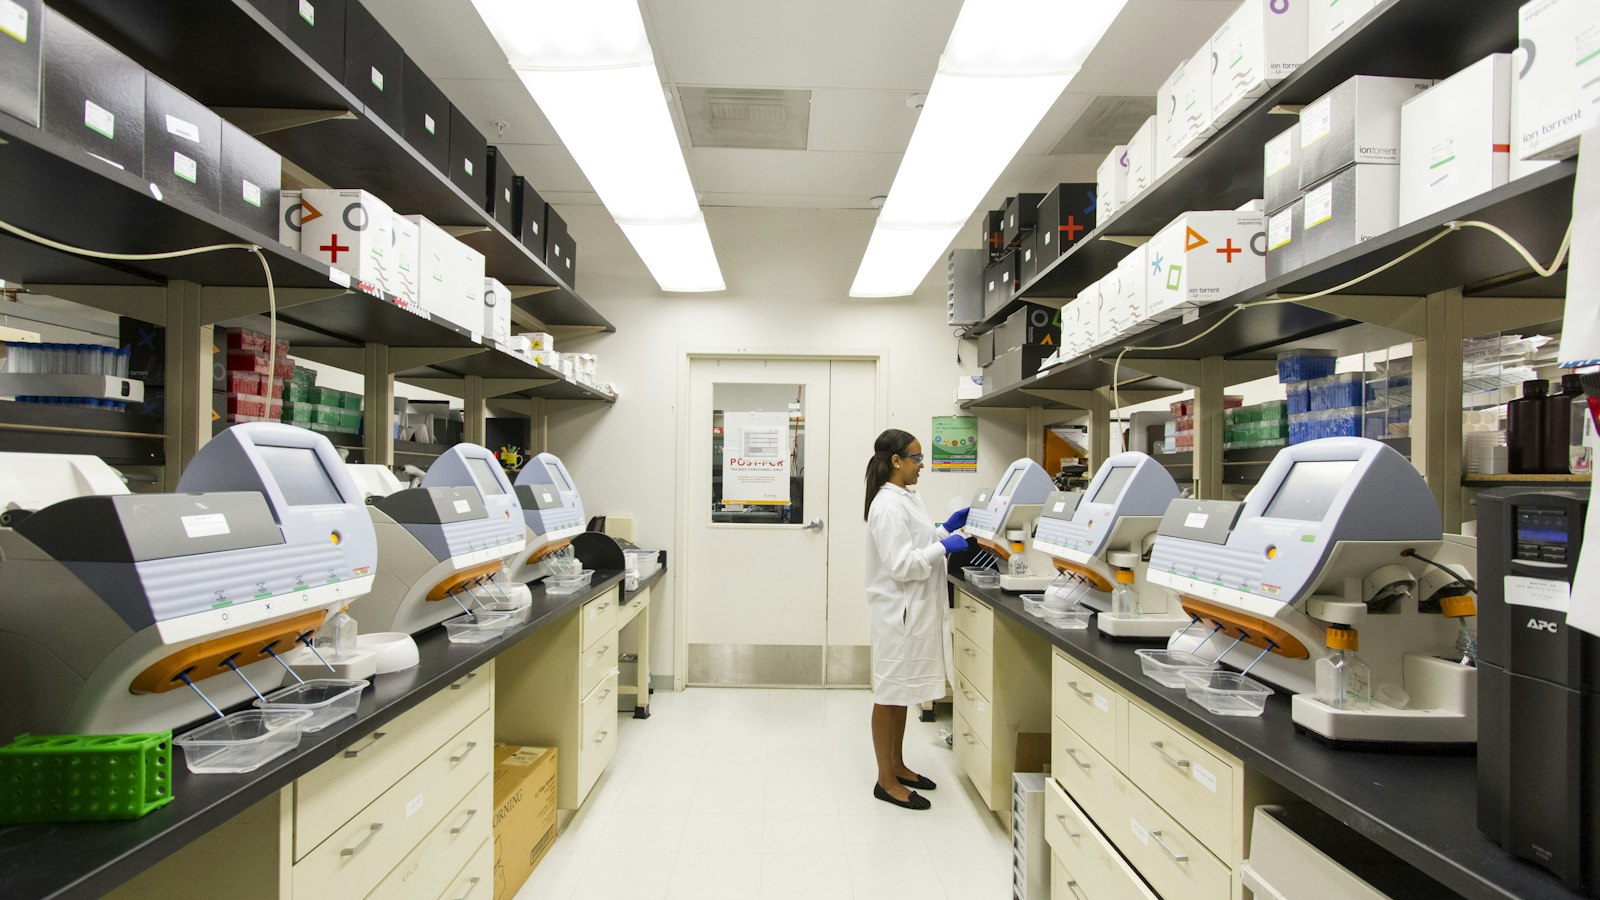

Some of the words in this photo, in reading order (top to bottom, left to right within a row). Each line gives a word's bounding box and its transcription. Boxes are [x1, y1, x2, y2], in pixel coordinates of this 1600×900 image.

[1522, 130, 1539, 144] ion
[1541, 109, 1582, 135] torrent
[1526, 618, 1558, 633] APC
[493, 788, 523, 828] ORNING
